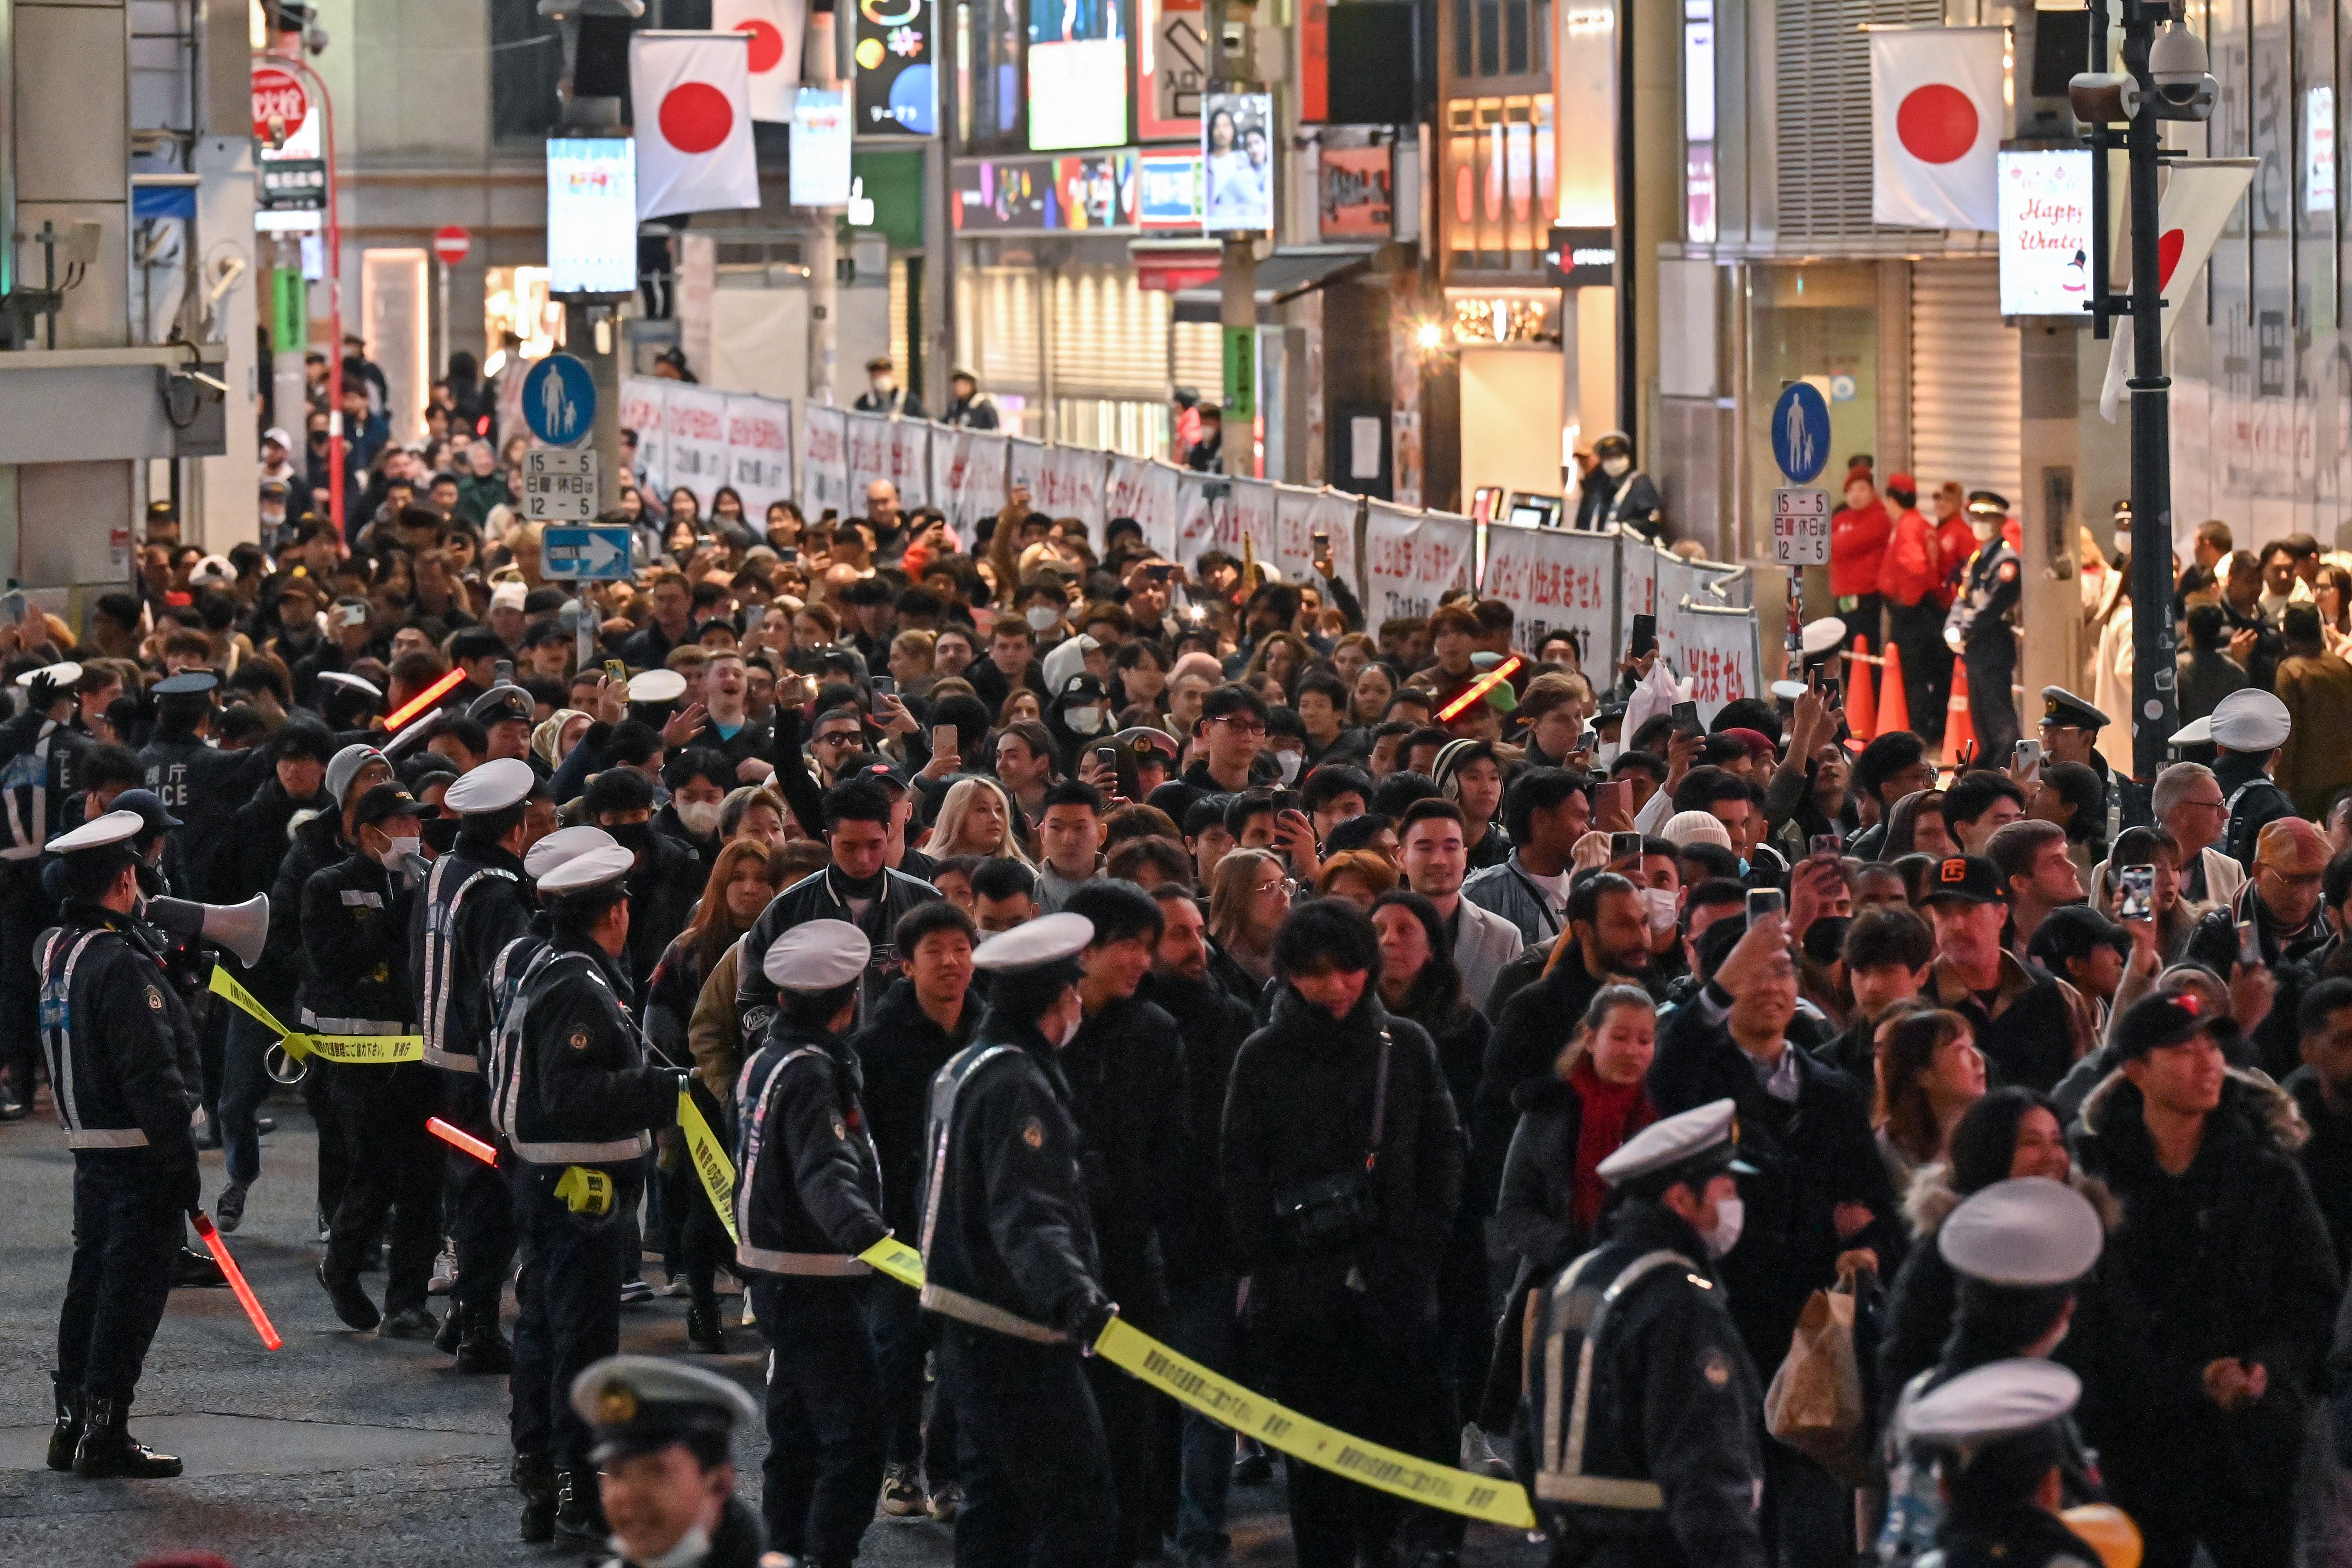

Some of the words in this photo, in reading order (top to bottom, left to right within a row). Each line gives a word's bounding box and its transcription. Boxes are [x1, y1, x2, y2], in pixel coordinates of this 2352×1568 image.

[2019, 198, 2084, 226] Happy
[2018, 230, 2084, 251] Winter
[531, 454, 545, 471] 15
[580, 455, 589, 473] 5
[531, 497, 545, 514] 12
[580, 498, 589, 514] 5
[1778, 494, 1789, 512] 15
[1816, 494, 1823, 512] 5
[1778, 541, 1789, 559] 12
[1816, 541, 1823, 559] 5
